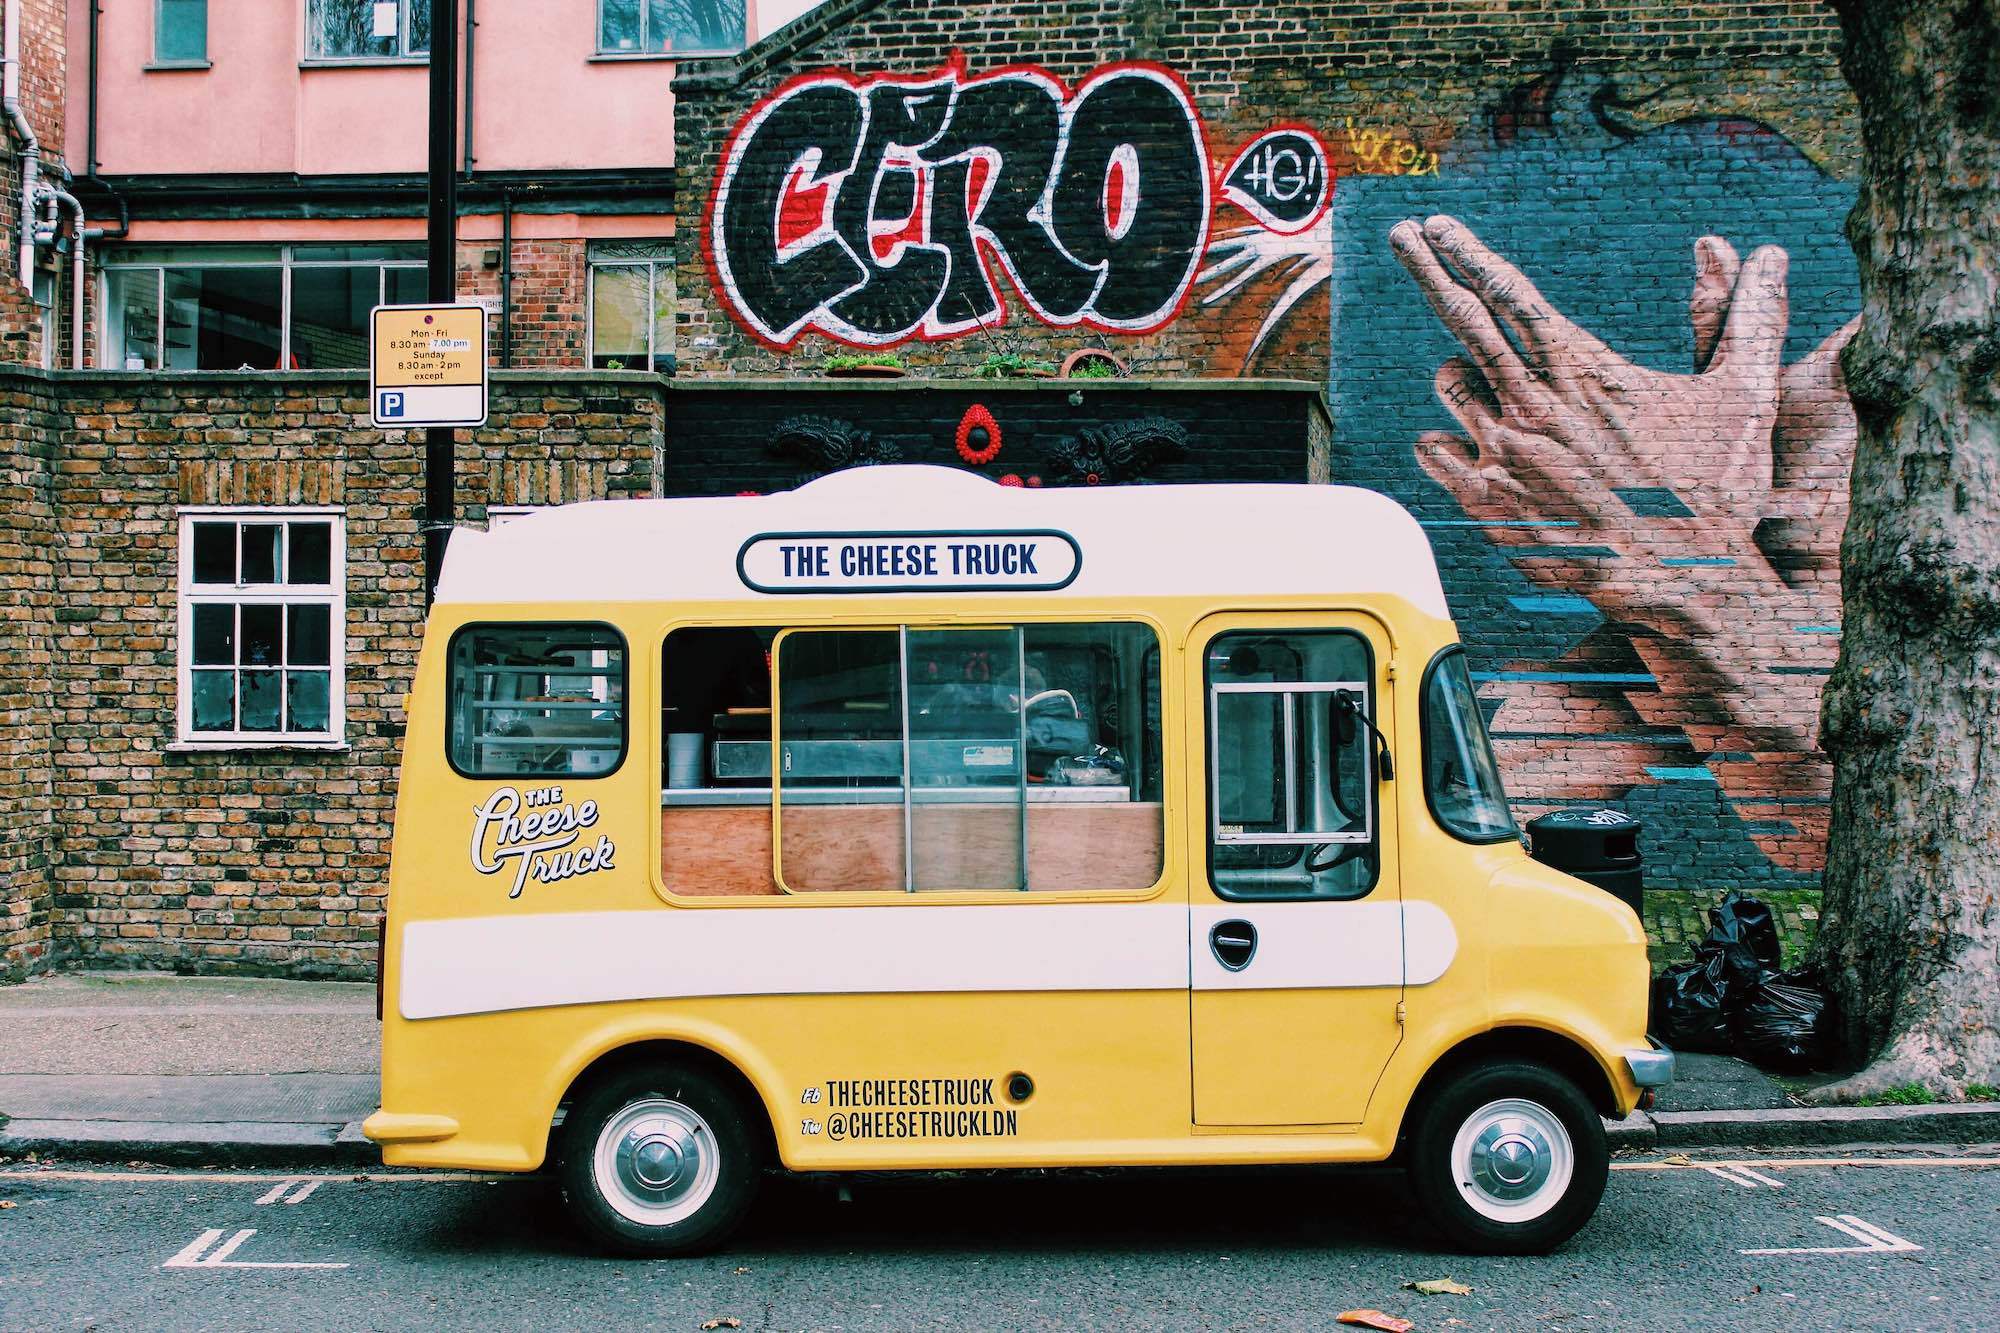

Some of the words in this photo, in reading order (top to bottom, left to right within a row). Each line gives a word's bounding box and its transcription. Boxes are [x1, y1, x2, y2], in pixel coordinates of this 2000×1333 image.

[1243, 144, 1317, 201] HG!
[390, 341, 411, 349] 8.30
[454, 340, 468, 349] pm
[411, 330, 430, 338] Mon
[436, 329, 448, 337] Fri
[398, 361, 419, 370] 8.30
[413, 351, 446, 360] Sunday
[414, 372, 444, 381] except
[384, 394, 401, 416] P
[780, 545, 830, 577] THE
[840, 544, 938, 576] CHEESE
[948, 543, 1038, 575] TRUCK
[525, 786, 563, 807] THE
[470, 786, 599, 875] Cheese
[493, 830, 615, 899] Truck
[801, 1087, 822, 1104] Fb
[826, 1078, 995, 1107] THECHEESETRUCK
[801, 1118, 822, 1135] Tw
[827, 1110, 1017, 1142] @CHEESETRUCKLDN
